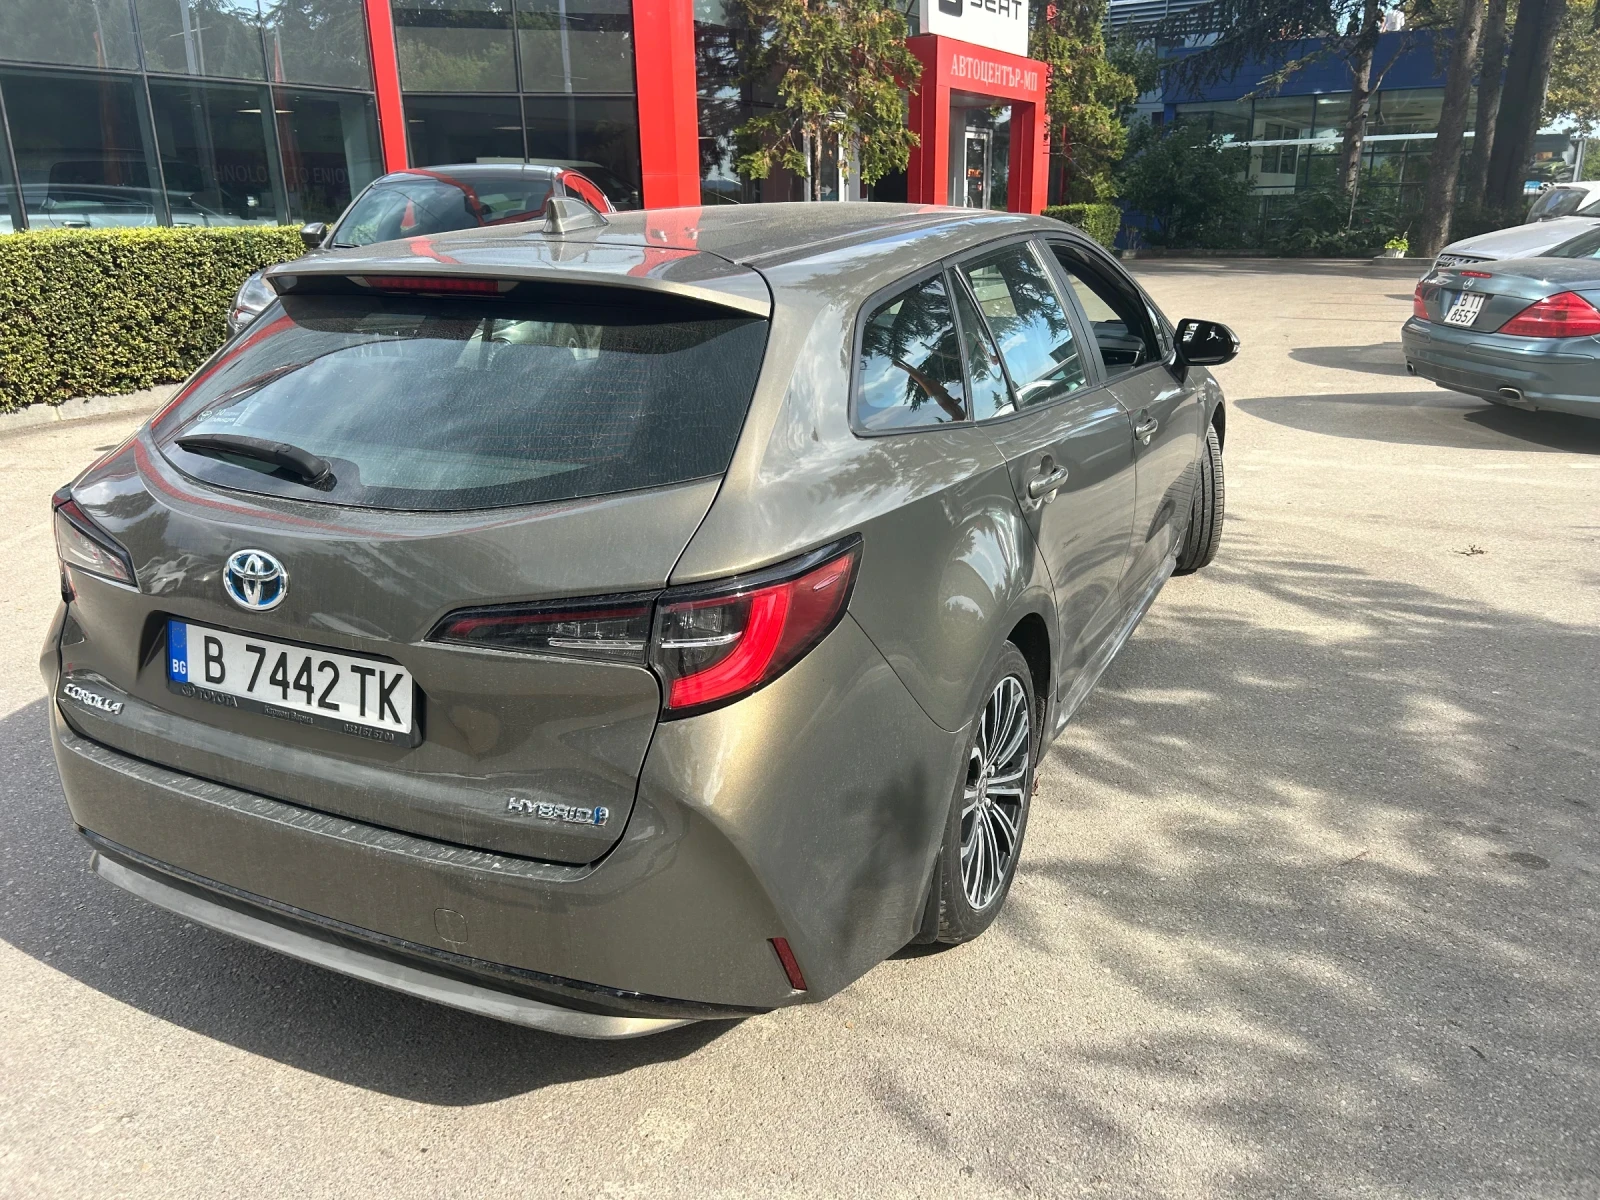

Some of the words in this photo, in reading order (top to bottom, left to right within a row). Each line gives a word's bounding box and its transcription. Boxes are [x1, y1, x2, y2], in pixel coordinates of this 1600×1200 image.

[950, 53, 1039, 92] АВТОЦЕНТЪР-МП
[1460, 292, 1469, 307] B
[1470, 293, 1485, 309] TT
[1450, 308, 1477, 324] 8557
[172, 658, 188, 675] BG
[204, 635, 226, 684] B
[245, 643, 341, 713] 7442
[350, 664, 405, 726] TK
[63, 682, 124, 715] COROLLA
[199, 688, 239, 708] TOYOTA
[507, 796, 593, 824] HYBRID
